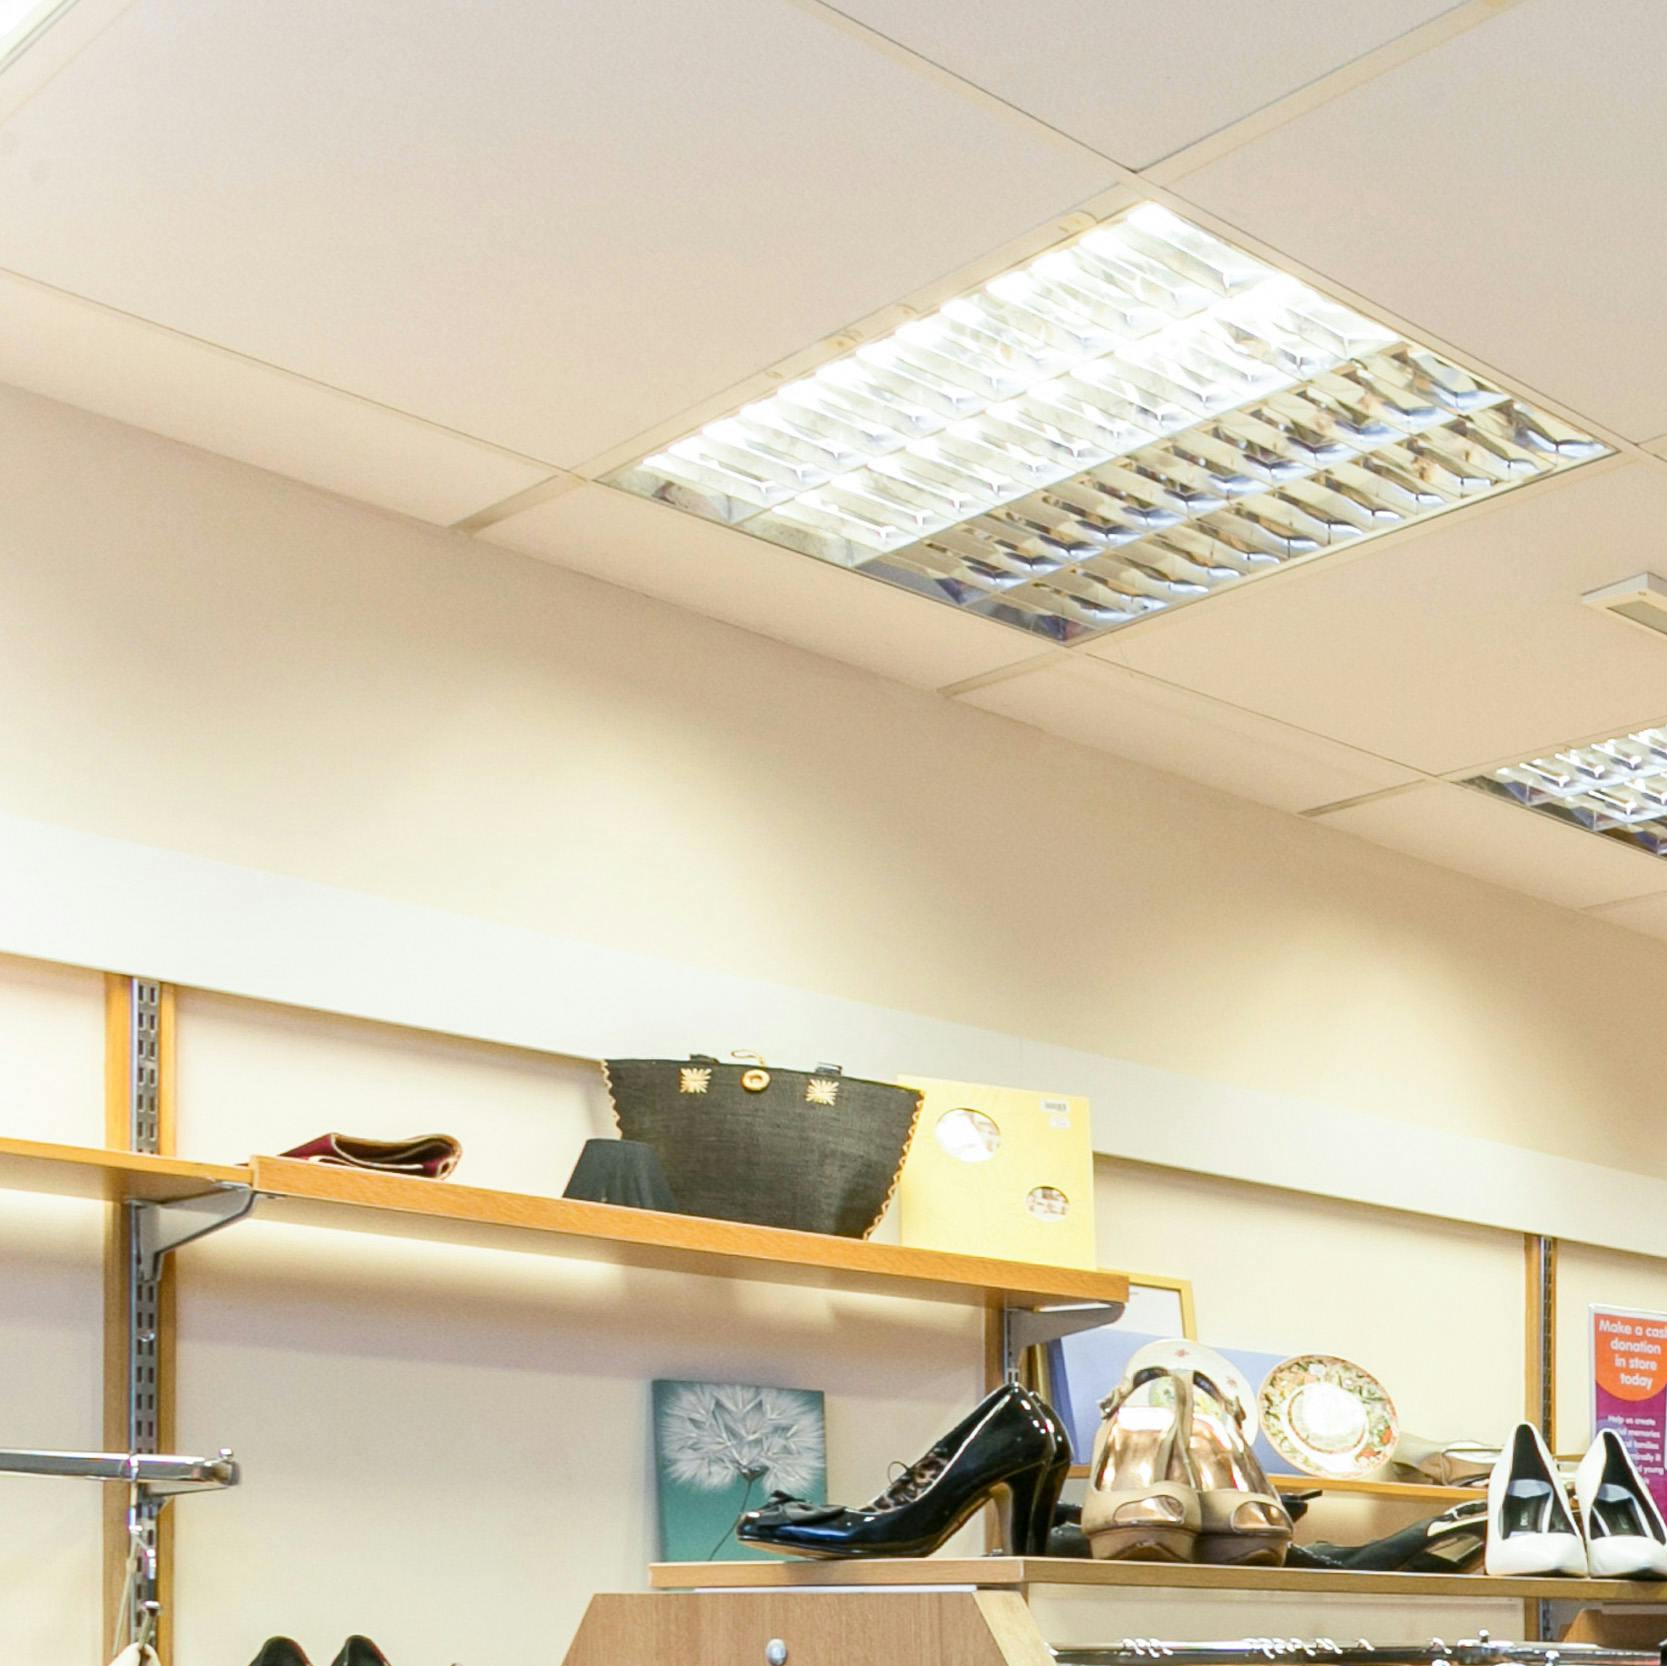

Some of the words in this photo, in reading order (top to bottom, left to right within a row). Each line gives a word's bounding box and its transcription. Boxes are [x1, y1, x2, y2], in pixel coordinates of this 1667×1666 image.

[1599, 1320, 1632, 1336] Make
[1635, 1326, 1643, 1336] a
[1610, 1338, 1662, 1355] donation
[1615, 1355, 1626, 1368] in
[1629, 1357, 1658, 1371] store
[1620, 1373, 1653, 1390] today
